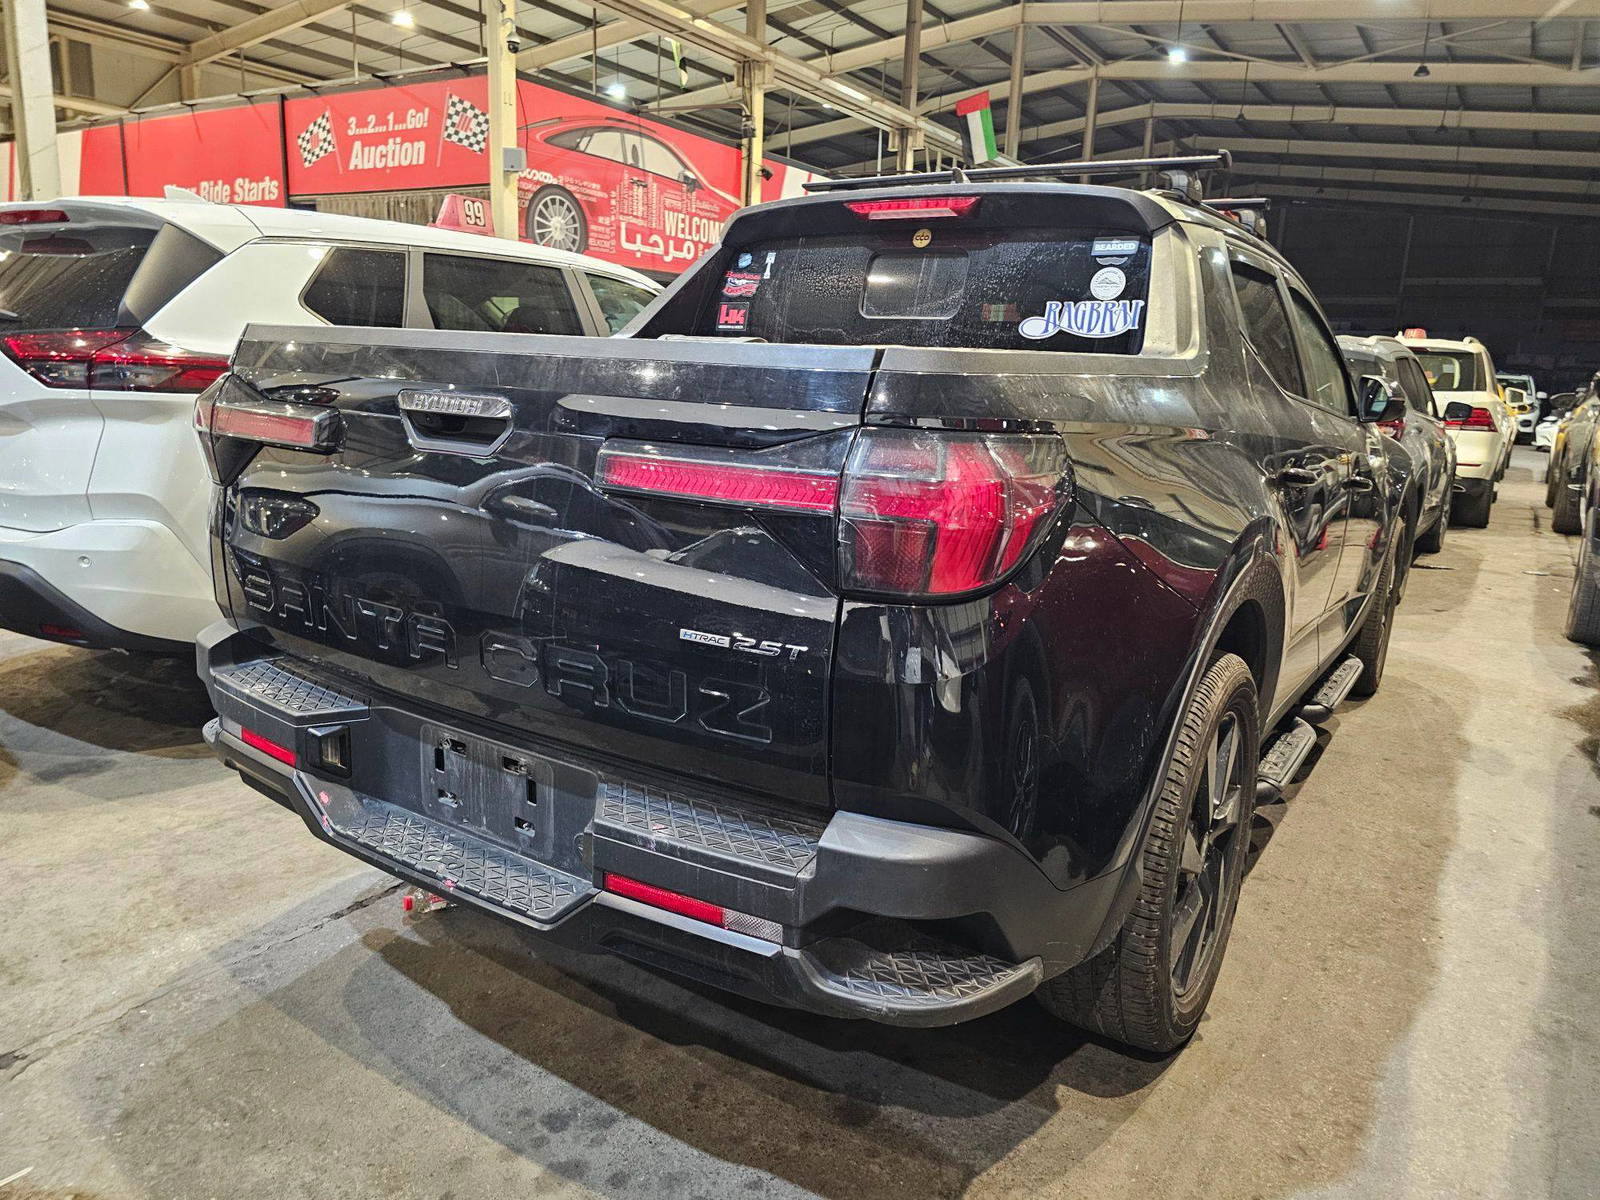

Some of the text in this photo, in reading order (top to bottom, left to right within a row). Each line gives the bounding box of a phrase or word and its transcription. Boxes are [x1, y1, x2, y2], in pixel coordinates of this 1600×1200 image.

[348, 136, 426, 171] Auction
[200, 179, 231, 203] Ride
[234, 176, 279, 202] Starts
[464, 200, 485, 226] 99
[620, 221, 696, 263] مرحبا
[1094, 242, 1137, 251] BEARDED
[1021, 300, 1143, 337] RAGBRAI
[414, 393, 484, 415] HYUNDAI
[244, 563, 458, 670] SANTA
[682, 630, 727, 646] HTRAC
[479, 630, 773, 743] CRUZ
